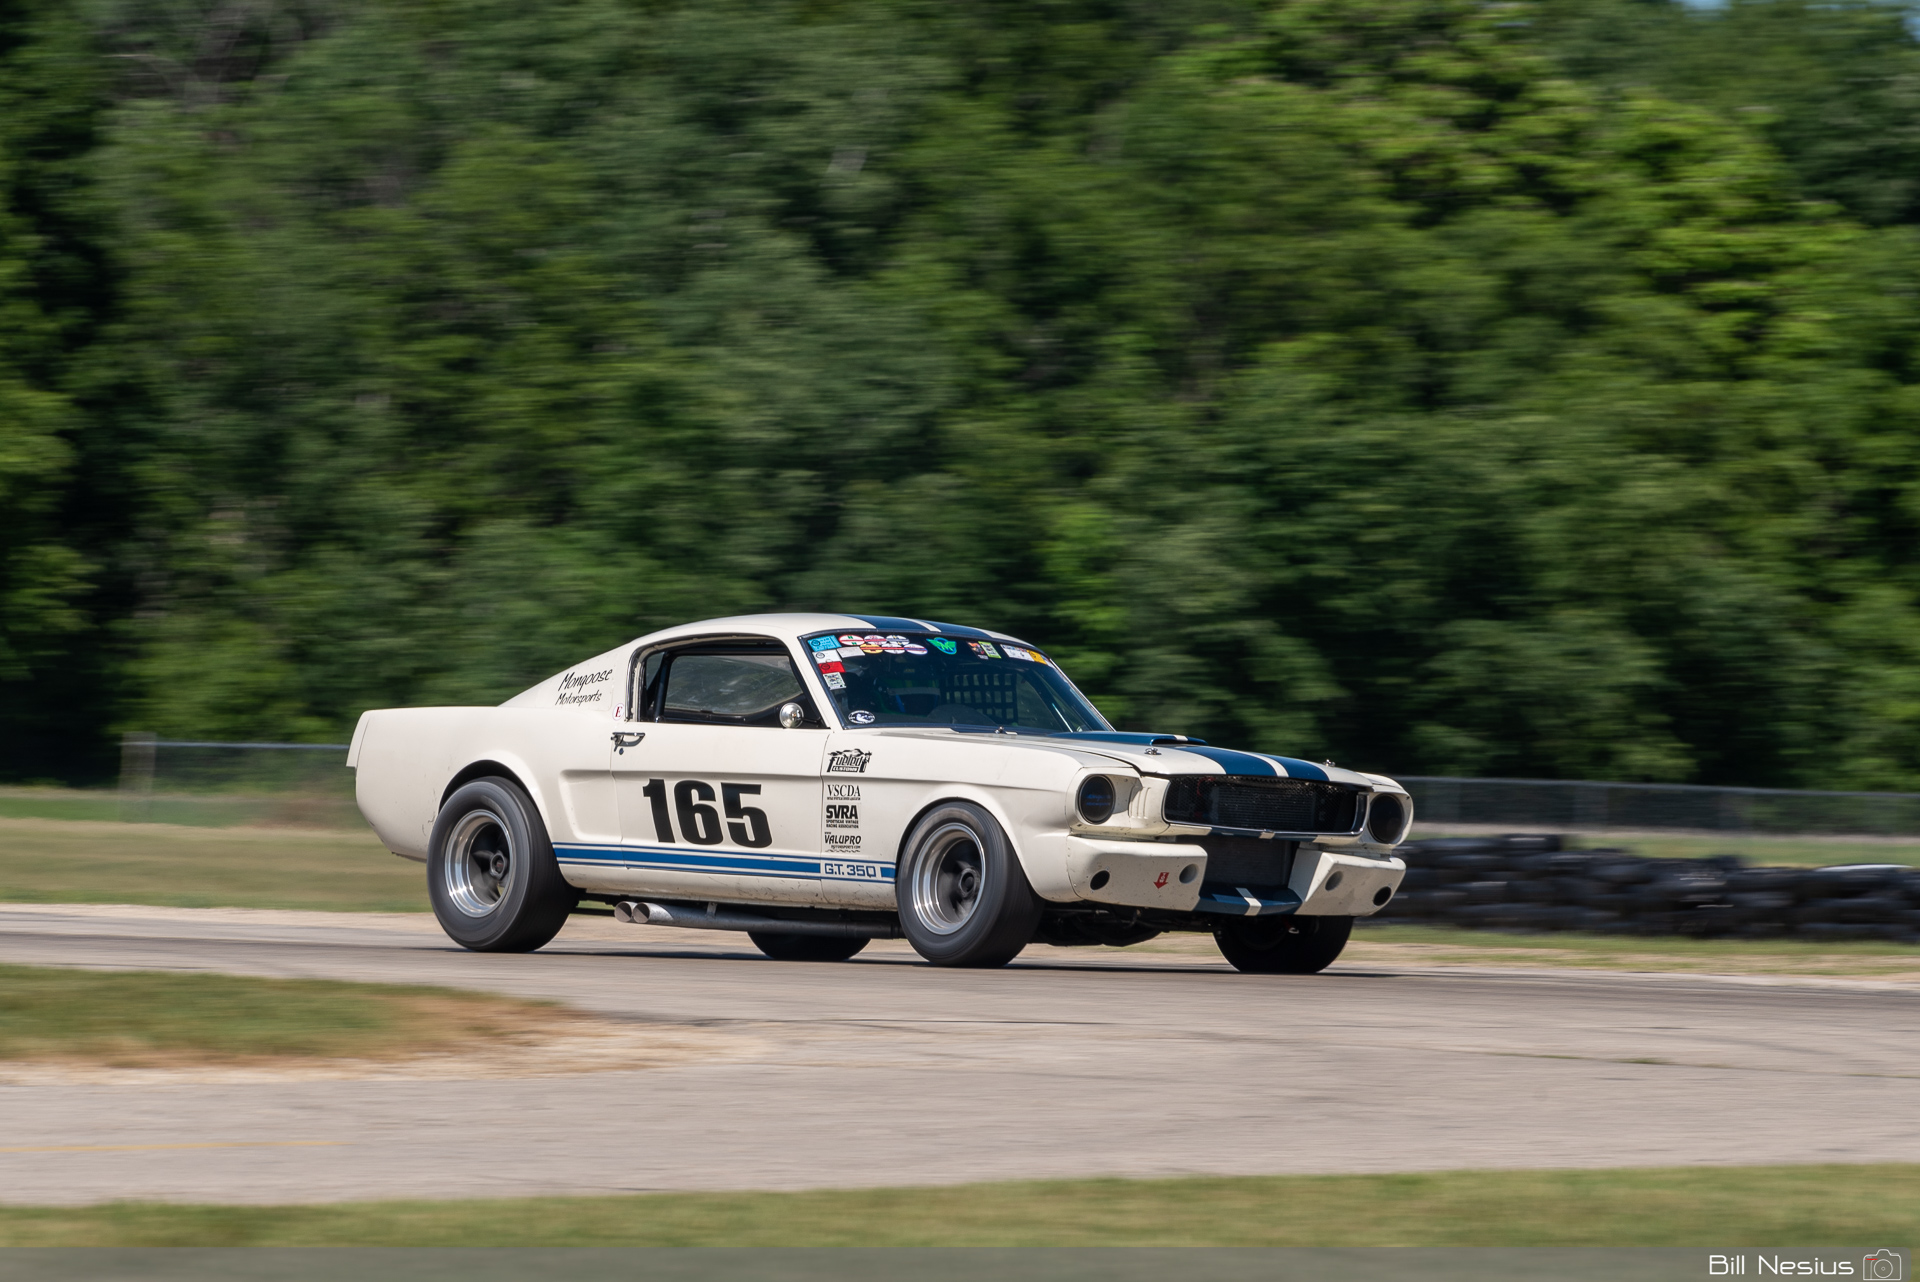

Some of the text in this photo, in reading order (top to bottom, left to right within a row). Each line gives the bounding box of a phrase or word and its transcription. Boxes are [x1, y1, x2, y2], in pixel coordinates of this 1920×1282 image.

[558, 669, 613, 694] Mongoose
[555, 689, 602, 707] Motorsports
[615, 706, 623, 717] E
[827, 784, 860, 797] VSCDA
[642, 778, 773, 848] 165
[826, 804, 858, 819] SVRA
[824, 834, 862, 845] VALUPRO
[824, 862, 877, 878] G.T. 350
